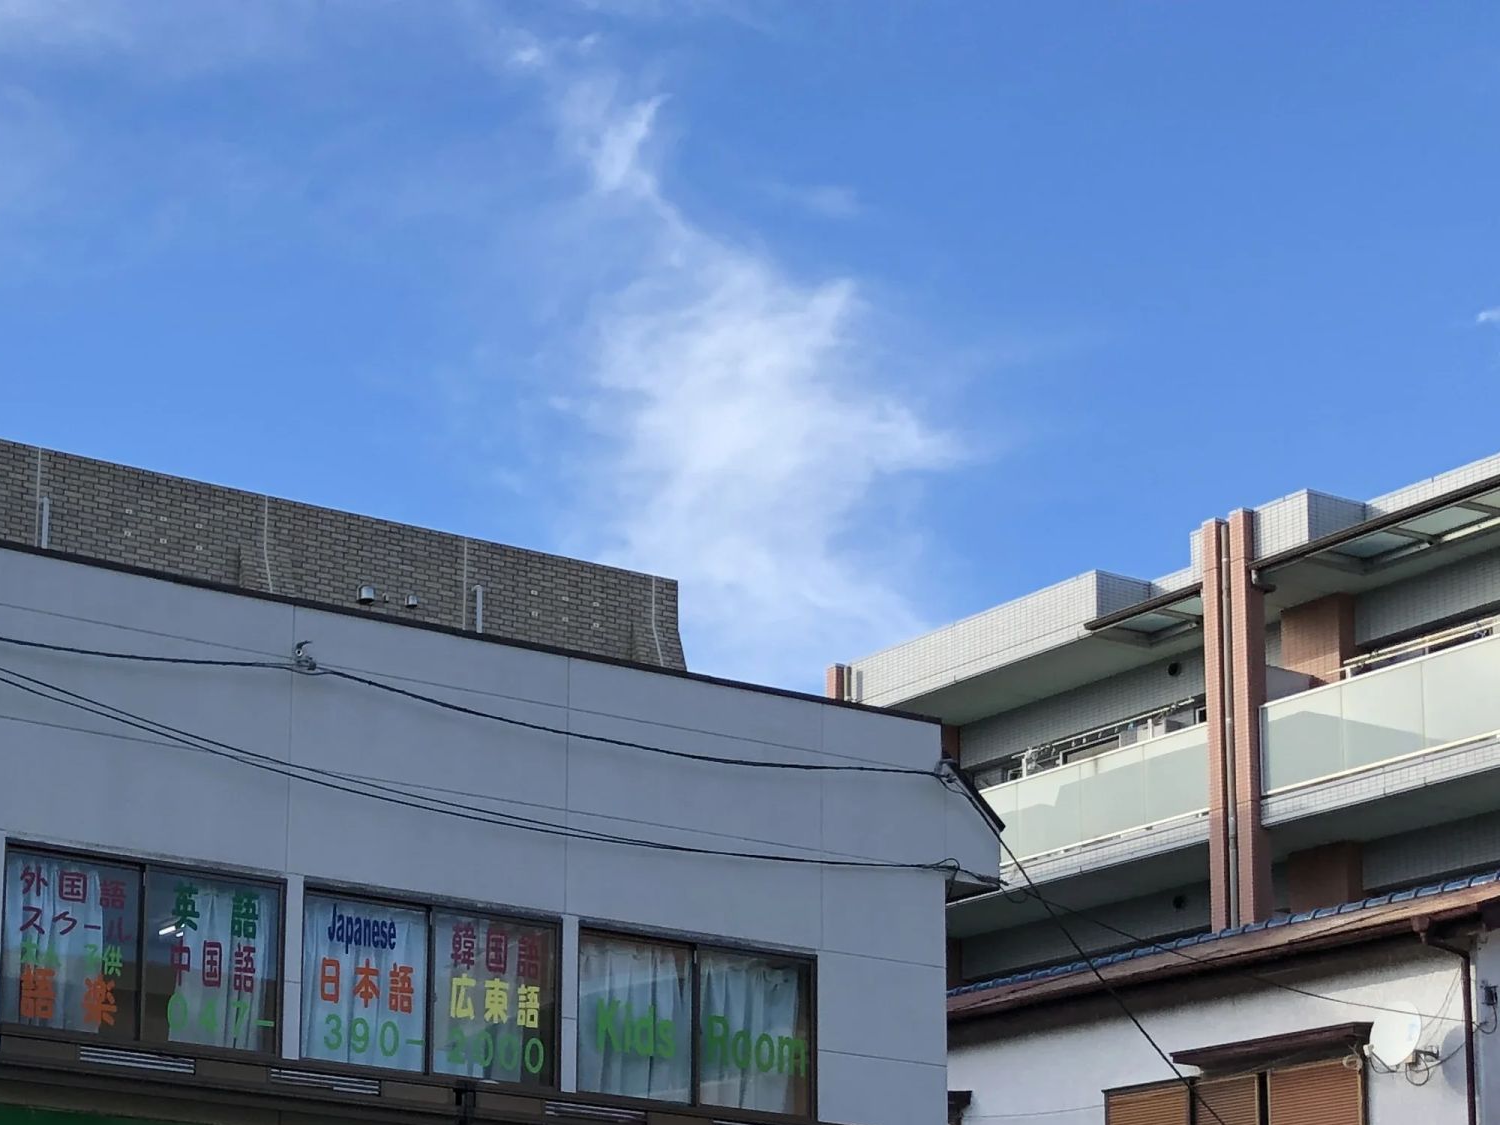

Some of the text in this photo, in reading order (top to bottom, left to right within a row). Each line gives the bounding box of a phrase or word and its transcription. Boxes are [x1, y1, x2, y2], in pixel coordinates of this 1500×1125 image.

[20, 864, 126, 910] 外国語
[171, 880, 259, 939] 英語
[19, 905, 132, 942] スクール
[327, 903, 397, 955] Japanese
[450, 922, 540, 980] 韓国語
[170, 935, 256, 992] 中国語
[319, 957, 414, 1014] 日本語
[449, 973, 540, 1029] 広東語
[595, 998, 807, 1078] Kids Room
